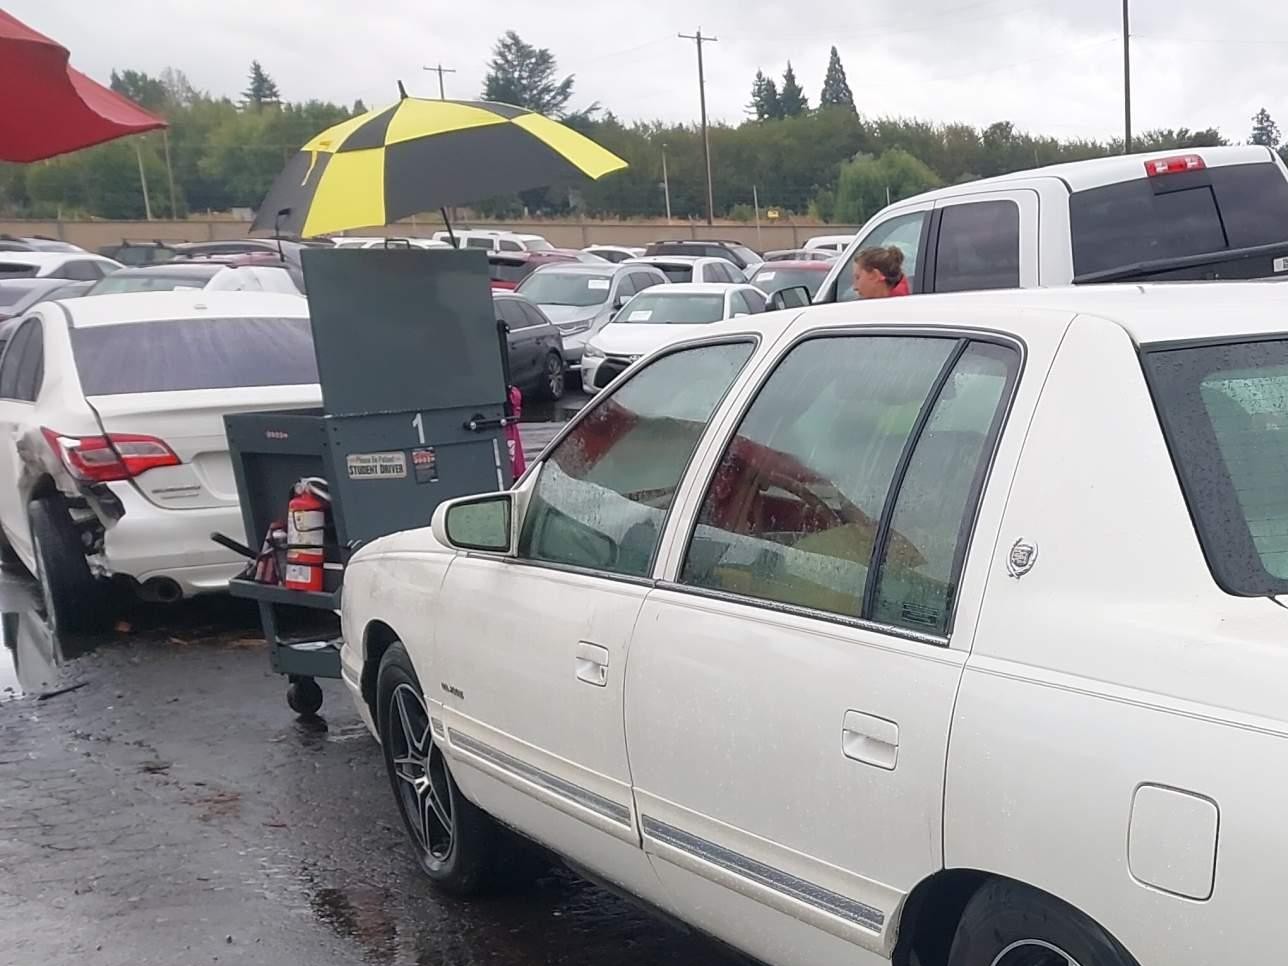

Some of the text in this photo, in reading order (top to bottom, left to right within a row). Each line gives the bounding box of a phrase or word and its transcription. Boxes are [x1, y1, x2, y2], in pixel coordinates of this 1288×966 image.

[412, 413, 425, 444] 1
[349, 464, 404, 475] STUDENT DRIVER
